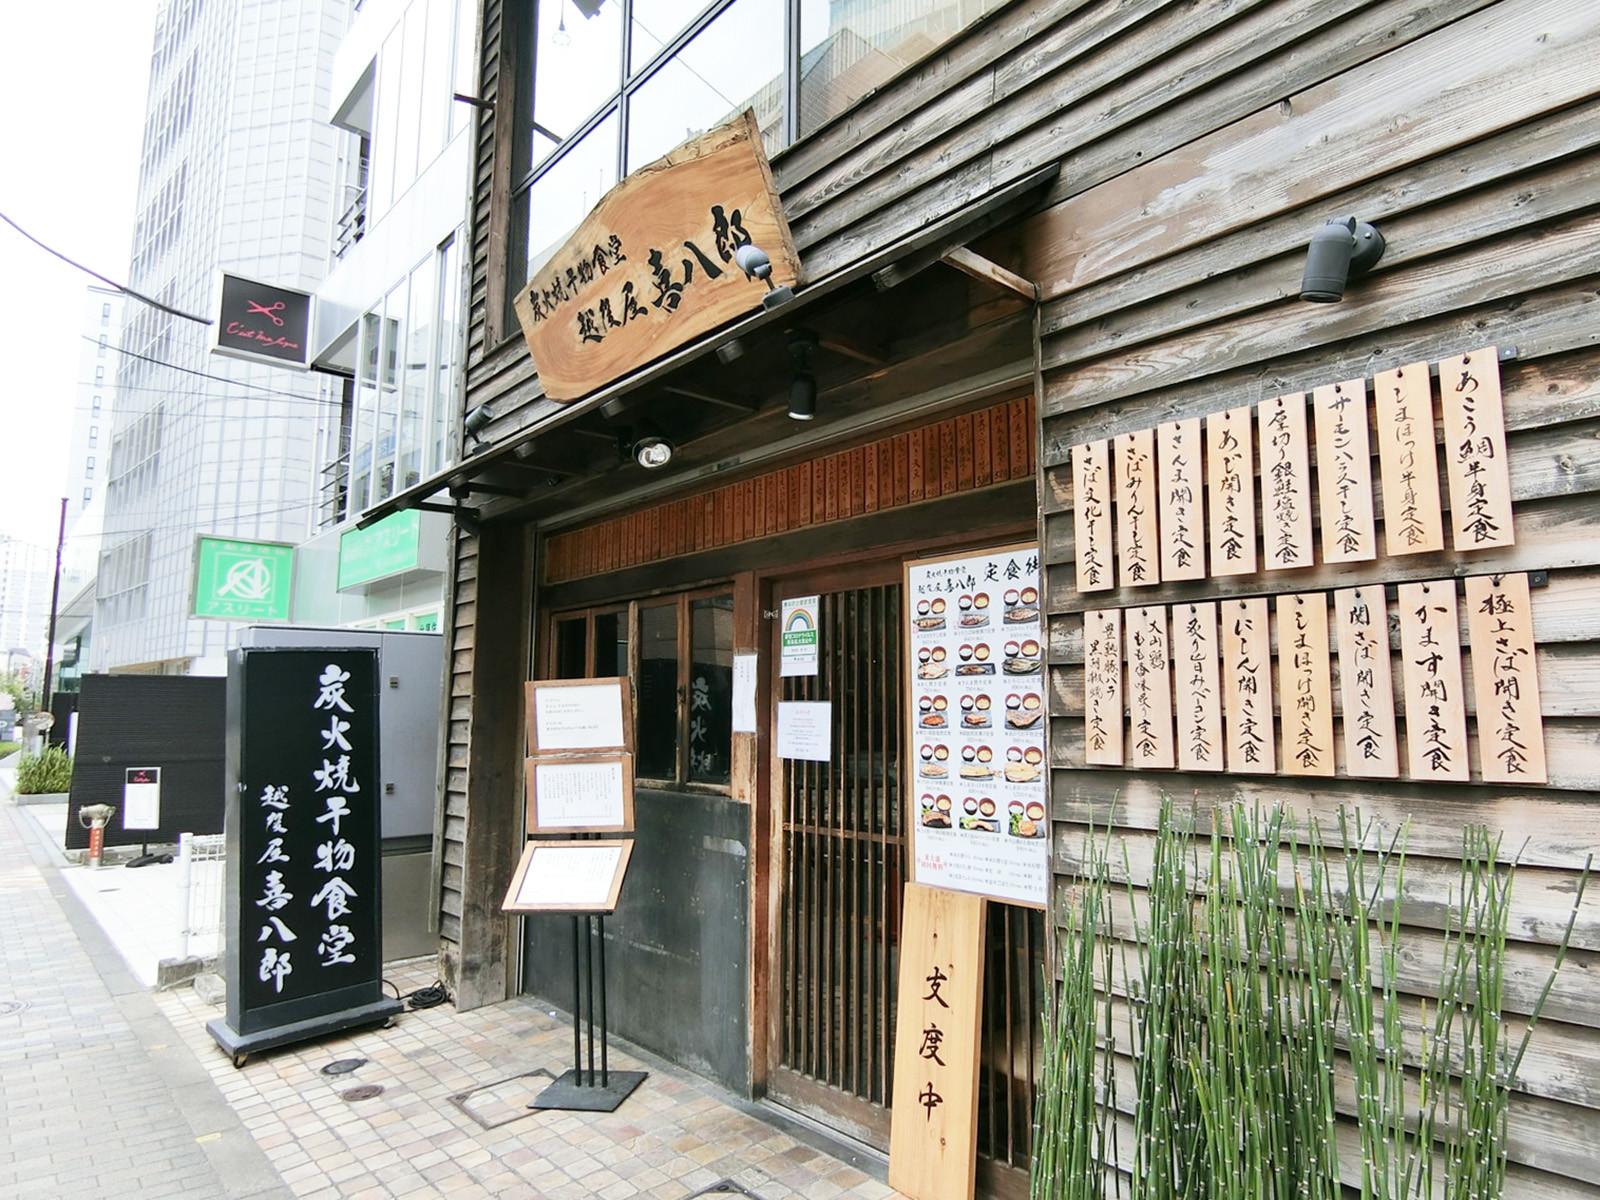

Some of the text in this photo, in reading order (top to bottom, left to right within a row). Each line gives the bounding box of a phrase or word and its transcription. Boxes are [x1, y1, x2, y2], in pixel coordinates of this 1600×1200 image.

[205, 602, 278, 615] アスリート
[919, 966, 950, 1123] 支度中
